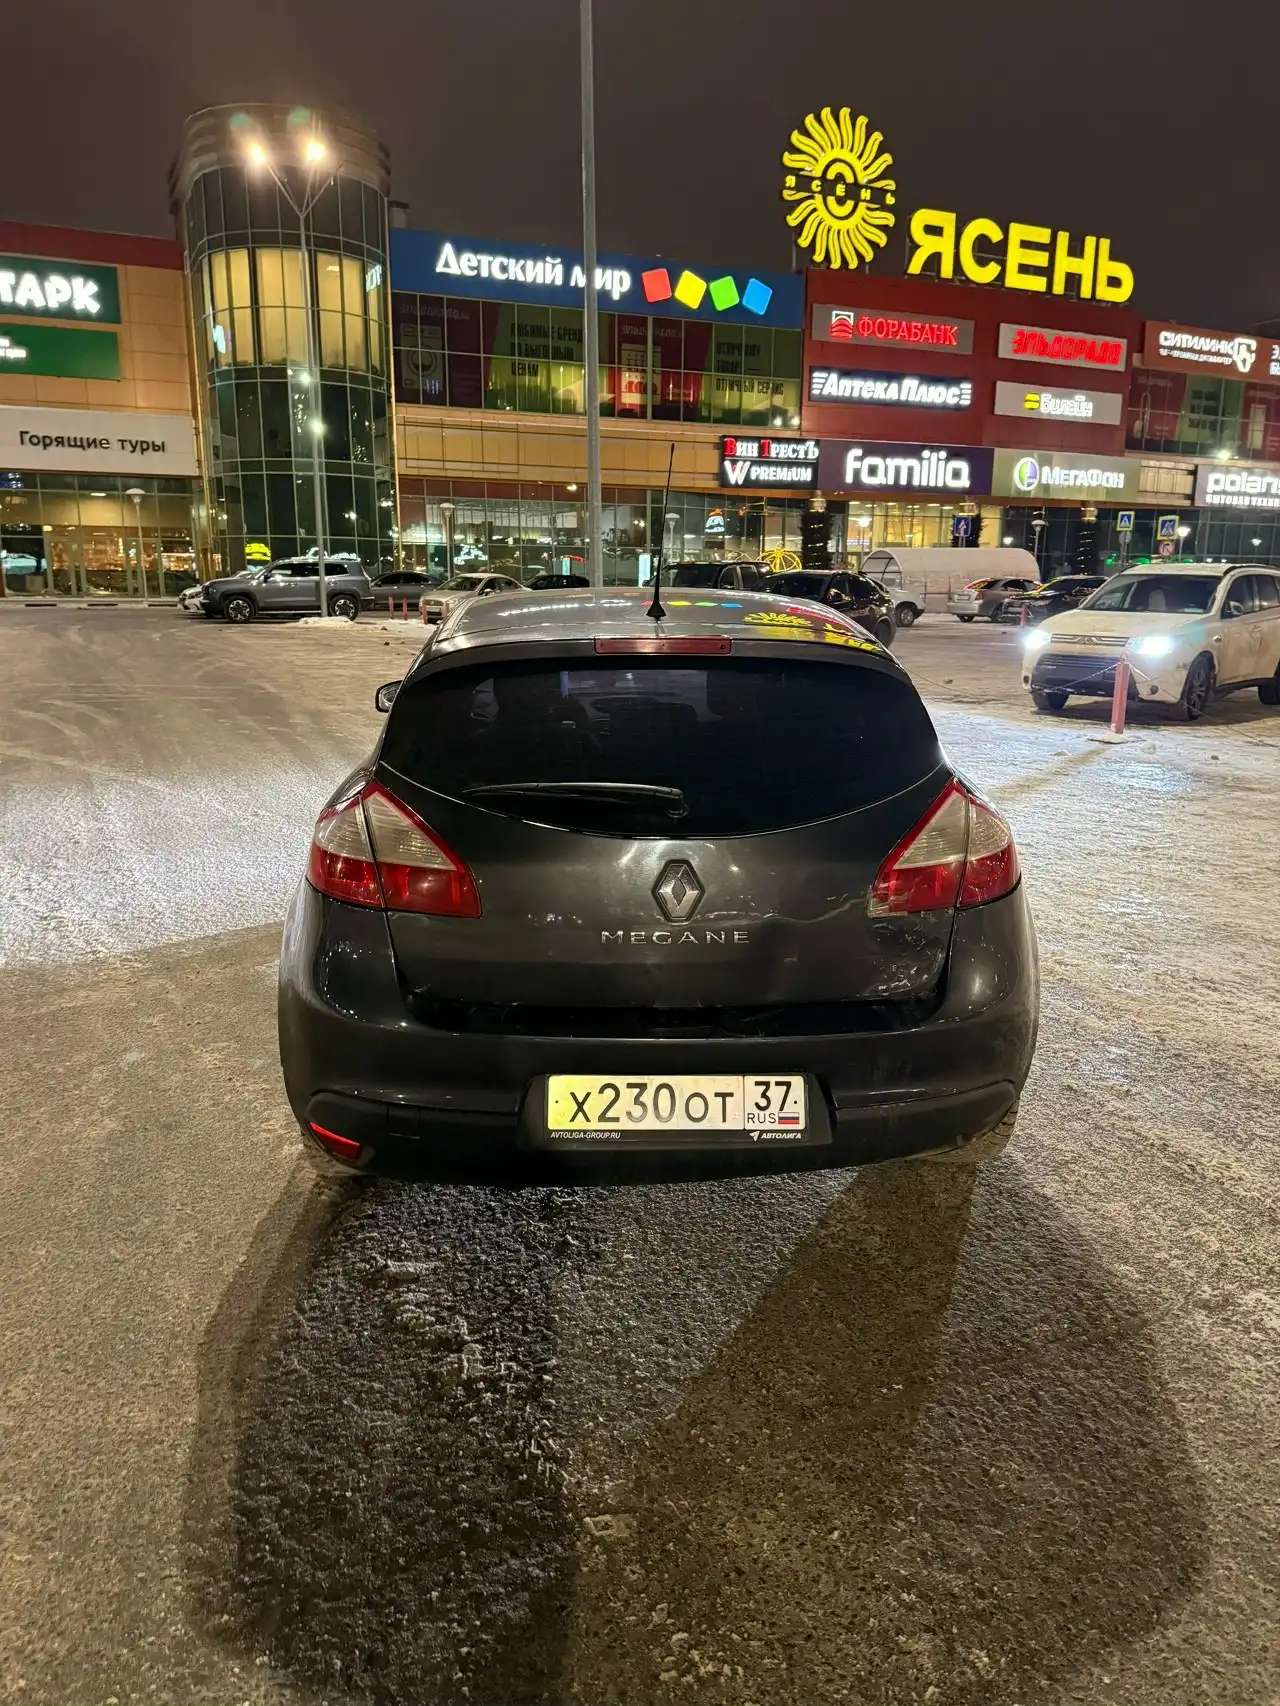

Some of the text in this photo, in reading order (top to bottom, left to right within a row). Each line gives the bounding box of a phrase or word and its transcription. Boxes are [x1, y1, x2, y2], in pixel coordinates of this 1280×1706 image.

[436, 242, 563, 286] Детский
[906, 208, 1135, 303] ЯСЕНЬ
[857, 316, 958, 346] ФОРАБАНК
[1159, 331, 1235, 354] СИТИЛИНК
[1012, 329, 1123, 366] ЭЛЬДОРАДО
[19, 430, 166, 455] Горящие туры
[844, 447, 971, 489] familia
[601, 930, 750, 945] MEGANE
[569, 1082, 735, 1123] Х230ОТ
[754, 1080, 792, 1112] 37
[747, 1112, 777, 1124] RUS
[550, 1131, 621, 1140] AVTOLIGA-GROUP.RU
[760, 1132, 802, 1140] АВТОЛИГА
